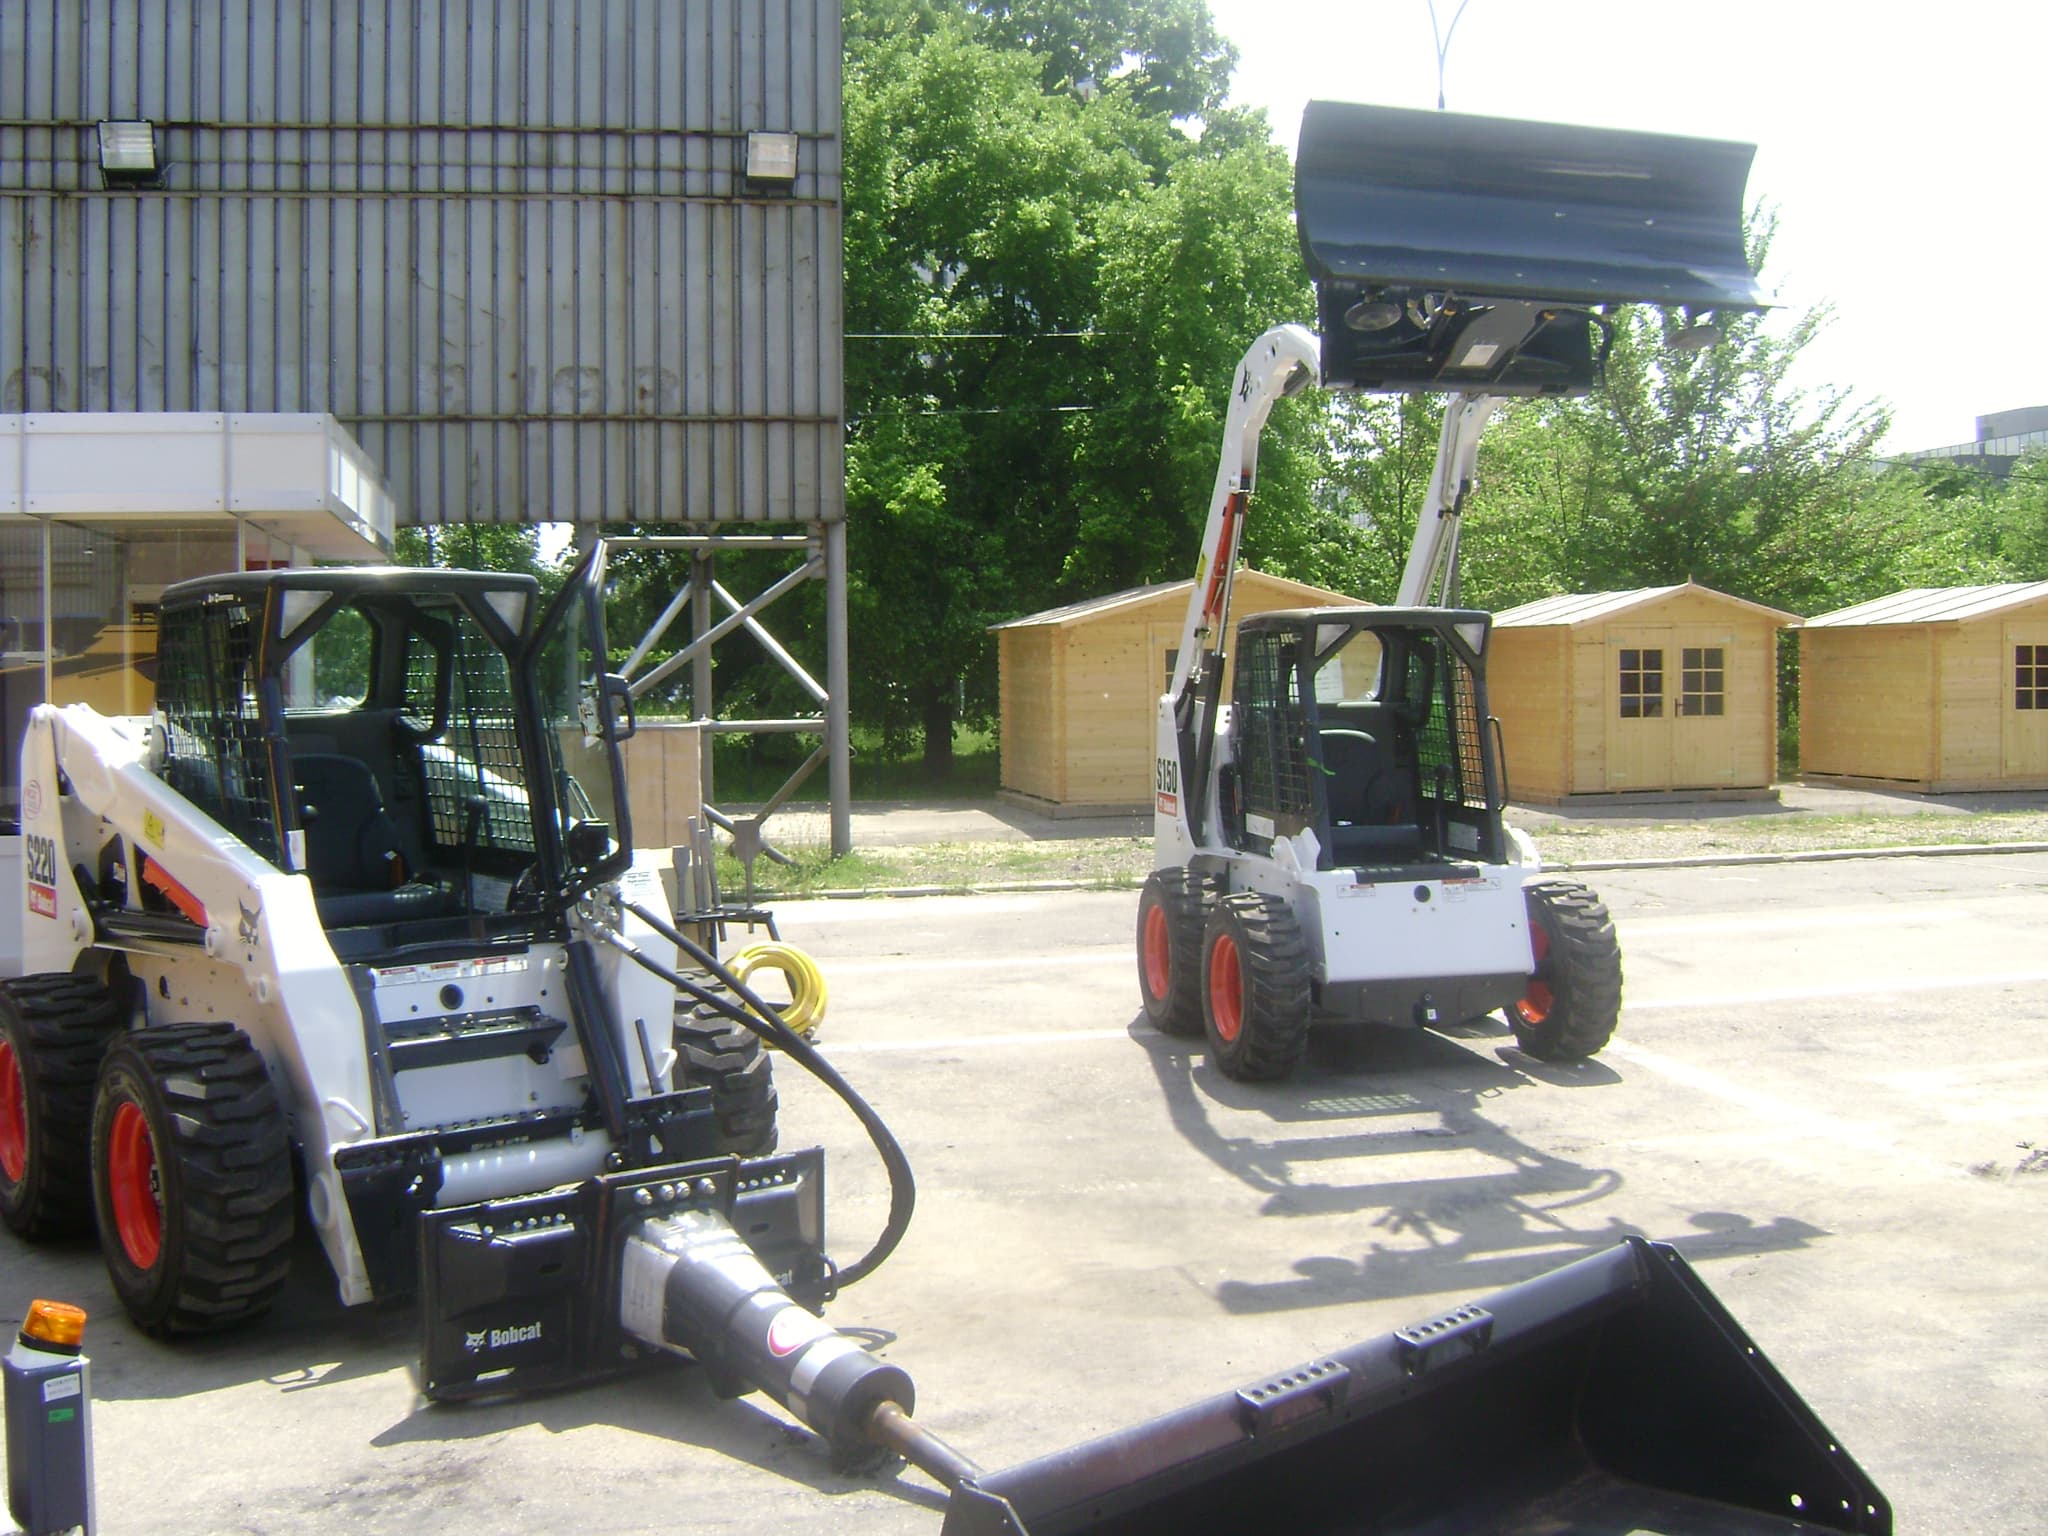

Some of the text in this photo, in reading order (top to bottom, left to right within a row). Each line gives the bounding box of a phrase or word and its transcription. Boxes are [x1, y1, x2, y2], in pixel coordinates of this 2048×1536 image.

[1157, 757, 1177, 794] S150
[27, 832, 56, 886] S220
[491, 1321, 543, 1347] Bobcat
